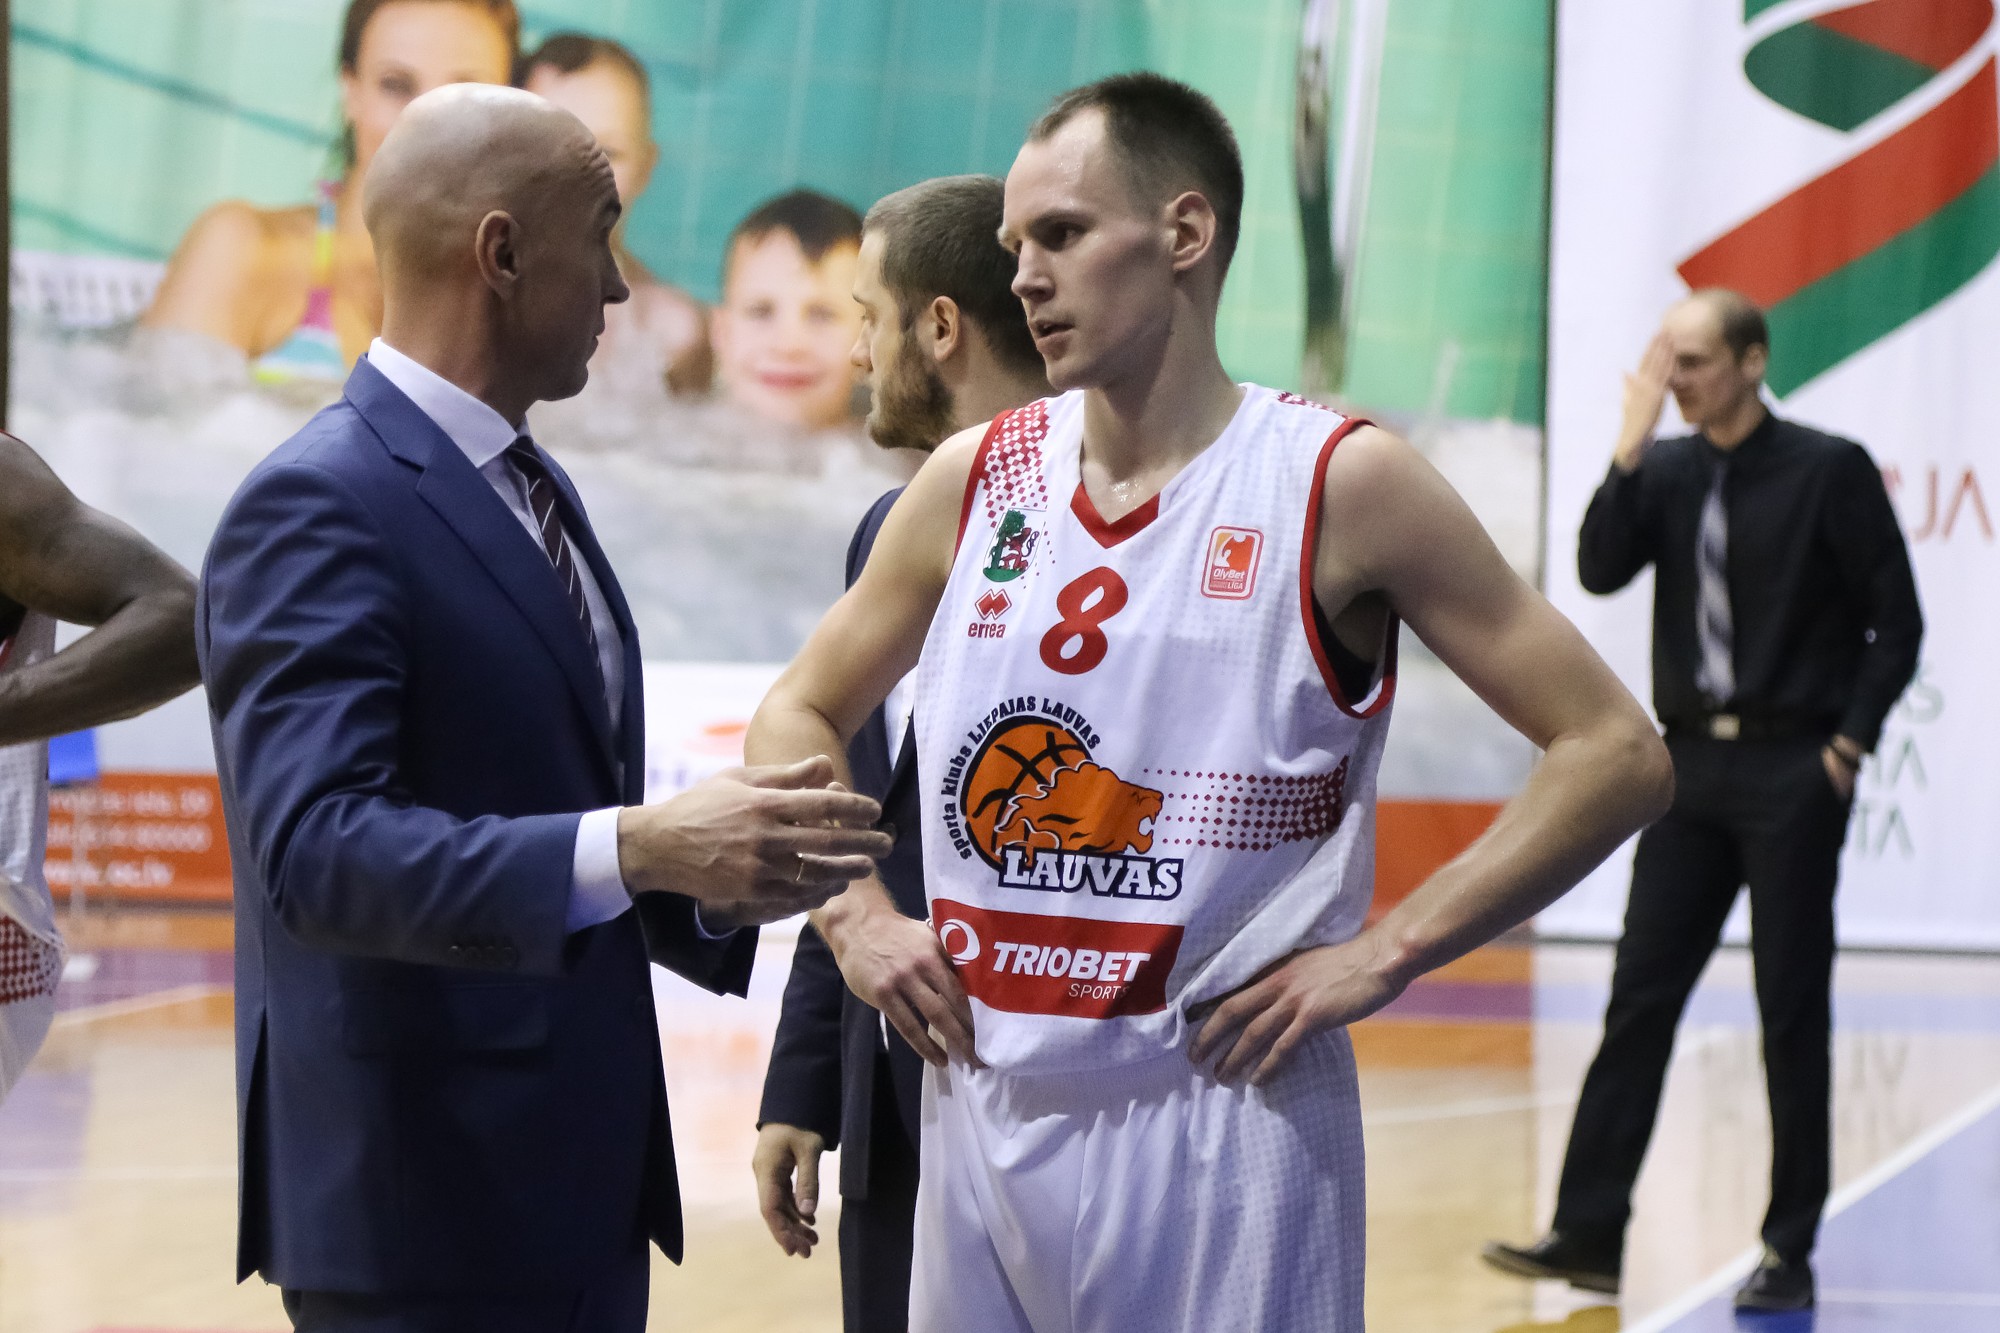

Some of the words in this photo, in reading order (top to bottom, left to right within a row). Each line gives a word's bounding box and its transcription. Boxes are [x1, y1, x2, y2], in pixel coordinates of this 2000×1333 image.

[1213, 568, 1246, 580] OlyBet
[1227, 581, 1244, 590] LIGA
[967, 622, 1007, 639] errea
[1039, 566, 1129, 675] 8
[967, 695, 1036, 745] LIEPAJAS
[1041, 697, 1101, 750] LAUVAS
[940, 745, 973, 797] klubs
[942, 802, 973, 860] sporta
[1001, 848, 1182, 899] LAUVAS
[993, 941, 1151, 982] TRIOBET
